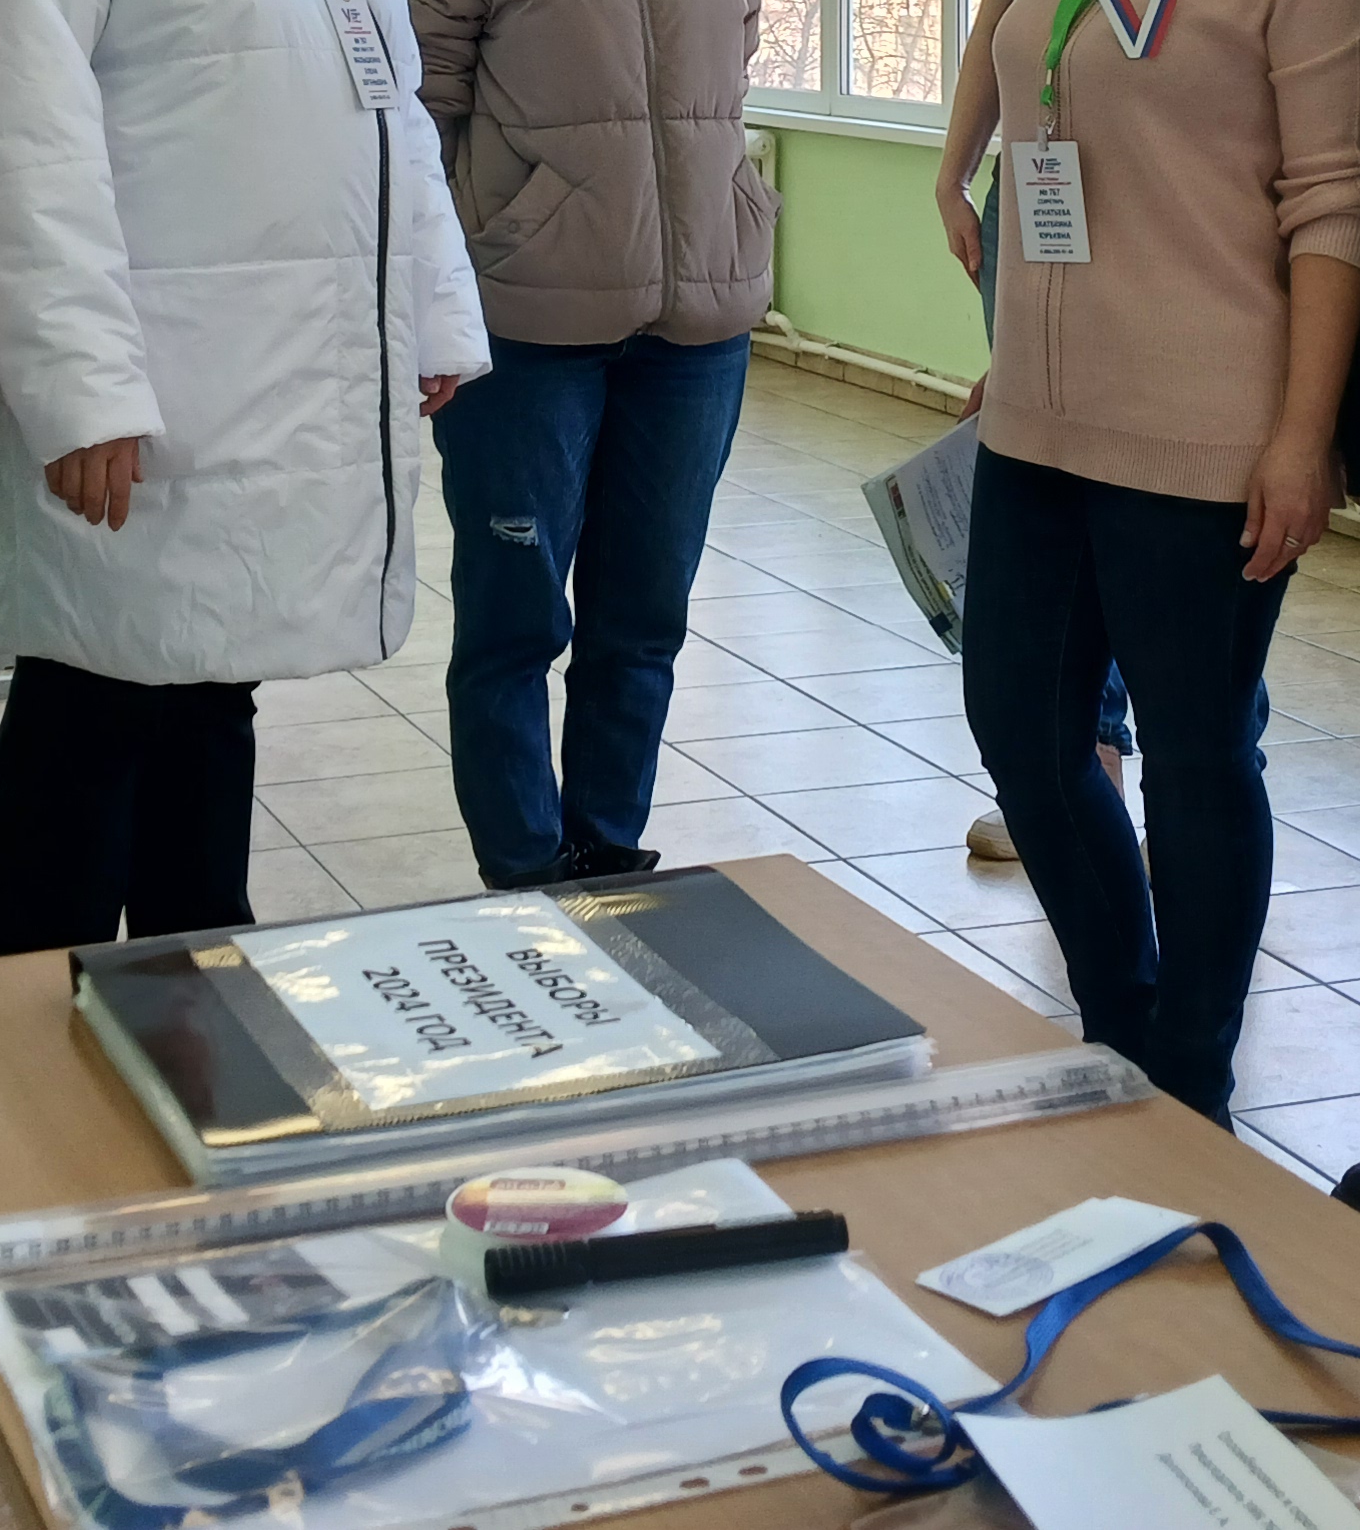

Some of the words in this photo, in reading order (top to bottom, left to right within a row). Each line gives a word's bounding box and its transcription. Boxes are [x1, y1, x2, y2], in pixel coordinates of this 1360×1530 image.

[362, 966, 430, 1013] 2024
[405, 1013, 471, 1054] ГОД
[417, 938, 563, 1058] ПРЕЗИДЕНТА
[506, 948, 621, 1027] ВЫБОРЫ
